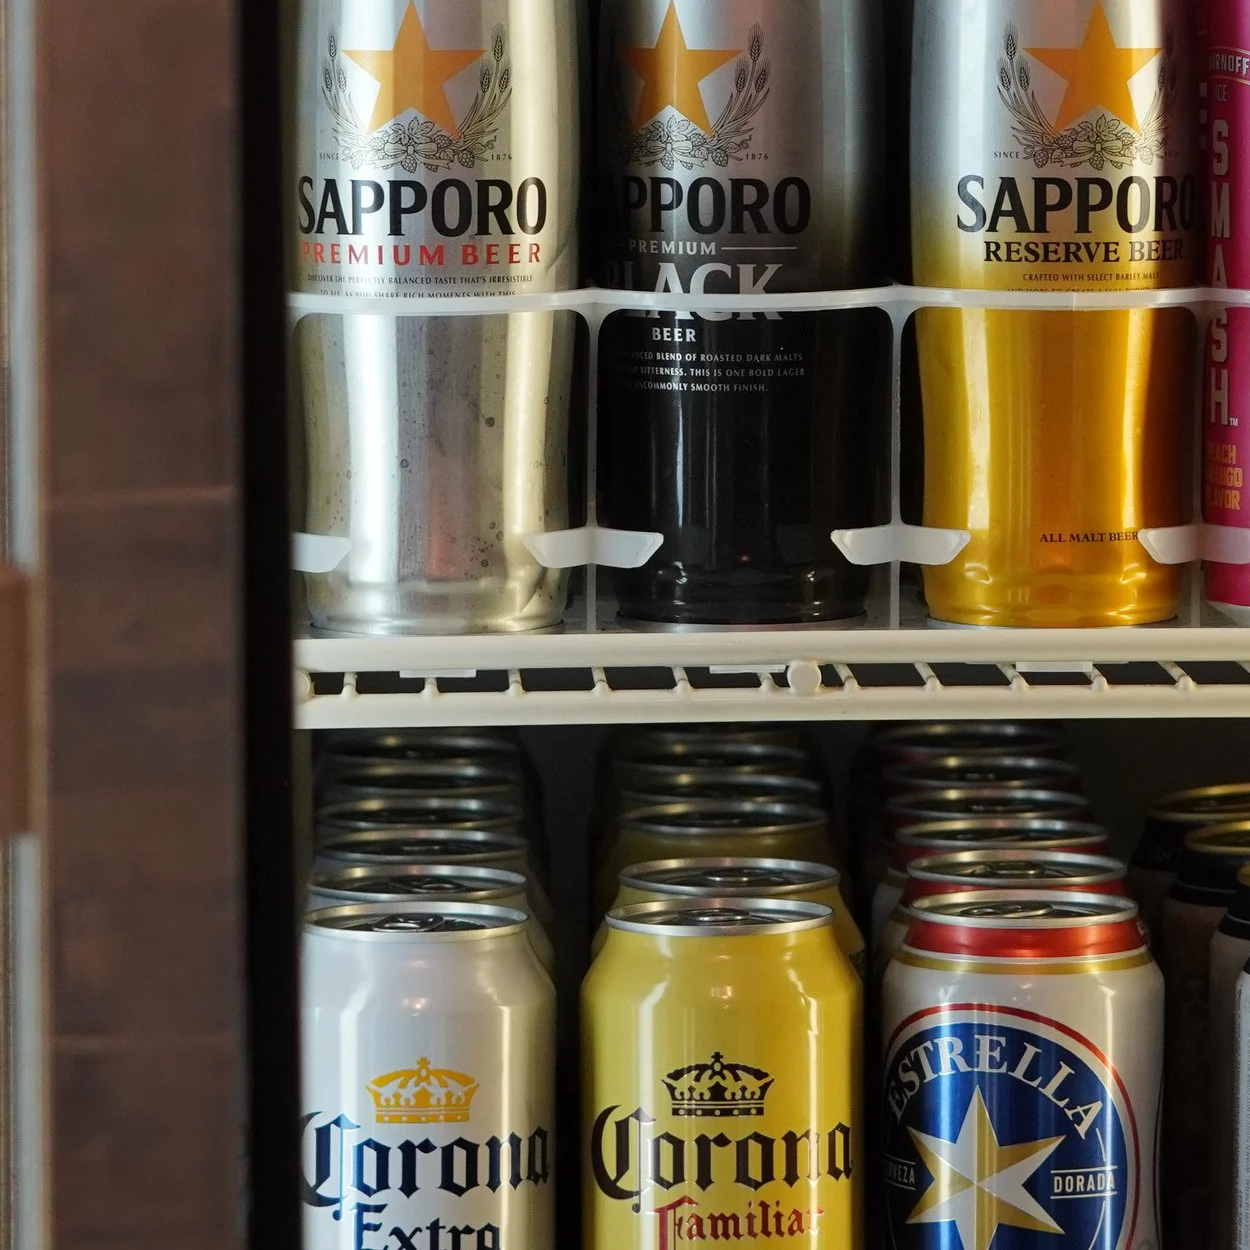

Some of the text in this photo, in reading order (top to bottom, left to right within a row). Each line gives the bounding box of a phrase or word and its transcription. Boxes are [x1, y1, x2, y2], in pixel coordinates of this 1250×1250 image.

[319, 152, 339, 161] SINCE
[993, 151, 1020, 160] SINCE
[299, 176, 547, 238] SAPPORO
[957, 175, 1197, 234] SAPPORO
[301, 243, 541, 266] PREMIUM BEER
[629, 240, 716, 255] PREMIUM
[984, 239, 1184, 263] RESERVE BEER
[388, 275, 533, 285] BALANCED TASTE THAT'S IRRESISTIBLE
[1023, 273, 1113, 282] CRAFTED WITH SELECT
[652, 327, 697, 343] BEER
[656, 352, 682, 361] BLEND
[685, 353, 697, 362] OF
[700, 353, 742, 362] ROASTED
[690, 368, 710, 377] THIS
[713, 368, 722, 377] IS
[691, 382, 730, 391] SMOOTH
[1039, 531, 1138, 543] ALL MALT BEER
[887, 1034, 1103, 1141] ESTRELLA
[301, 1111, 552, 1221] Corona
[592, 1104, 854, 1214] Corona
[1053, 1171, 1115, 1194] DORADA
